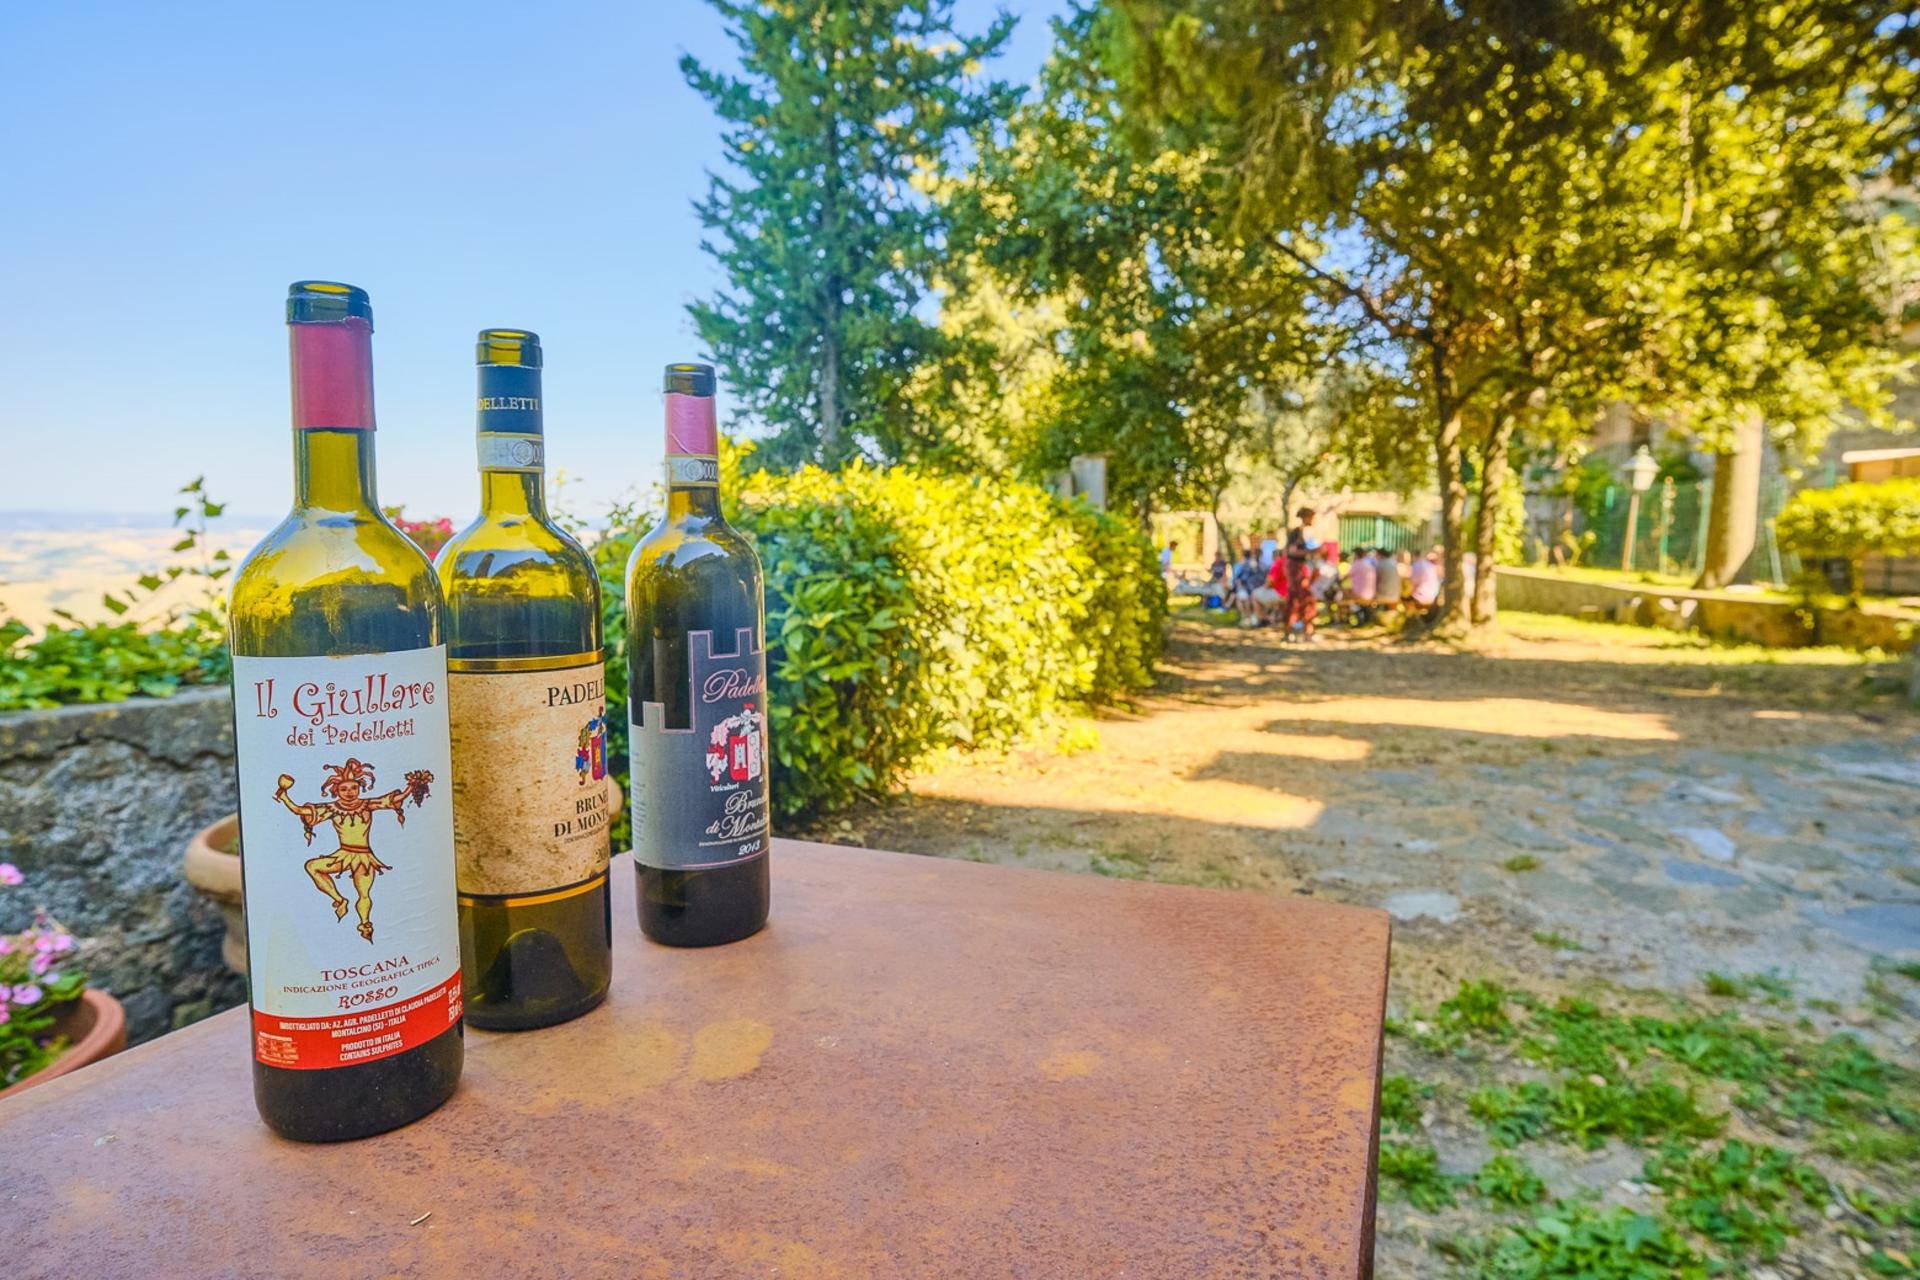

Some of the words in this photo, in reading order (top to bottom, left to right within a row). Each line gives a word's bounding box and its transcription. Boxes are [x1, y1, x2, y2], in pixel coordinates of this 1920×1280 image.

[254, 679, 278, 718] Il
[292, 672, 435, 726] Giullare
[286, 726, 315, 746] dei
[322, 718, 415, 746] Padelletti
[554, 821, 572, 837] DI
[705, 819, 720, 835] di
[283, 983, 348, 993] INDICAZIONE
[351, 967, 415, 989] GEOGRAFICA
[416, 955, 441, 972] TIPICA
[320, 955, 410, 982] TOSCANA
[337, 985, 399, 1009] ROSSO
[331, 1024, 372, 1038] MONTALCINO
[388, 1015, 406, 1028] ITALIA
[332, 1020, 343, 1029] AZ.
[359, 1009, 395, 1026] PADELLETTI
[339, 1048, 371, 1061] CONTAINS
[371, 1040, 404, 1056] SULPHITES
[341, 1038, 374, 1052] PRODOTTO
[382, 1031, 401, 1045] ITALIA
